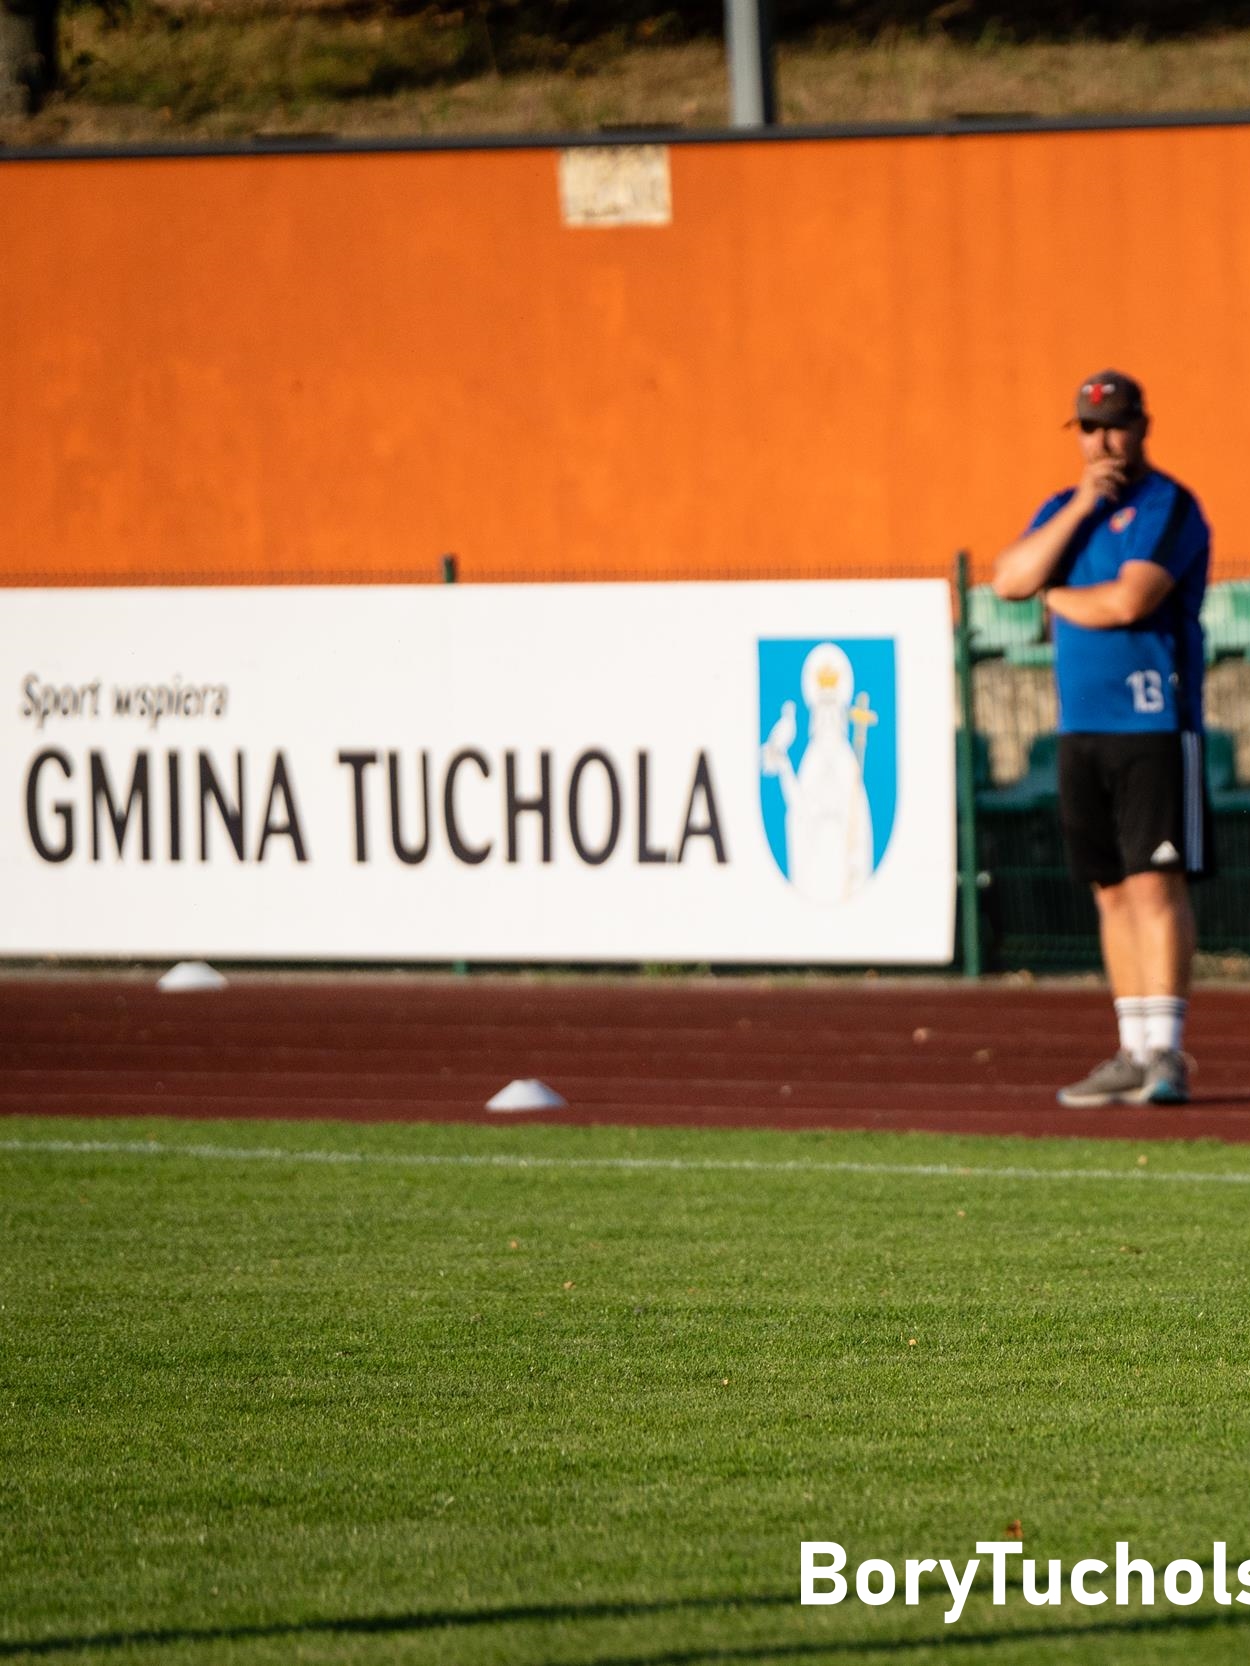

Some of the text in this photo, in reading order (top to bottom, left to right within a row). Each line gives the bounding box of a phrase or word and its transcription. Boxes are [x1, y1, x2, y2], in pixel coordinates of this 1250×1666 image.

[21, 671, 228, 731] Sport wspiera
[1125, 669, 1165, 713] 13
[25, 746, 731, 867] GMINA TUCHOLA
